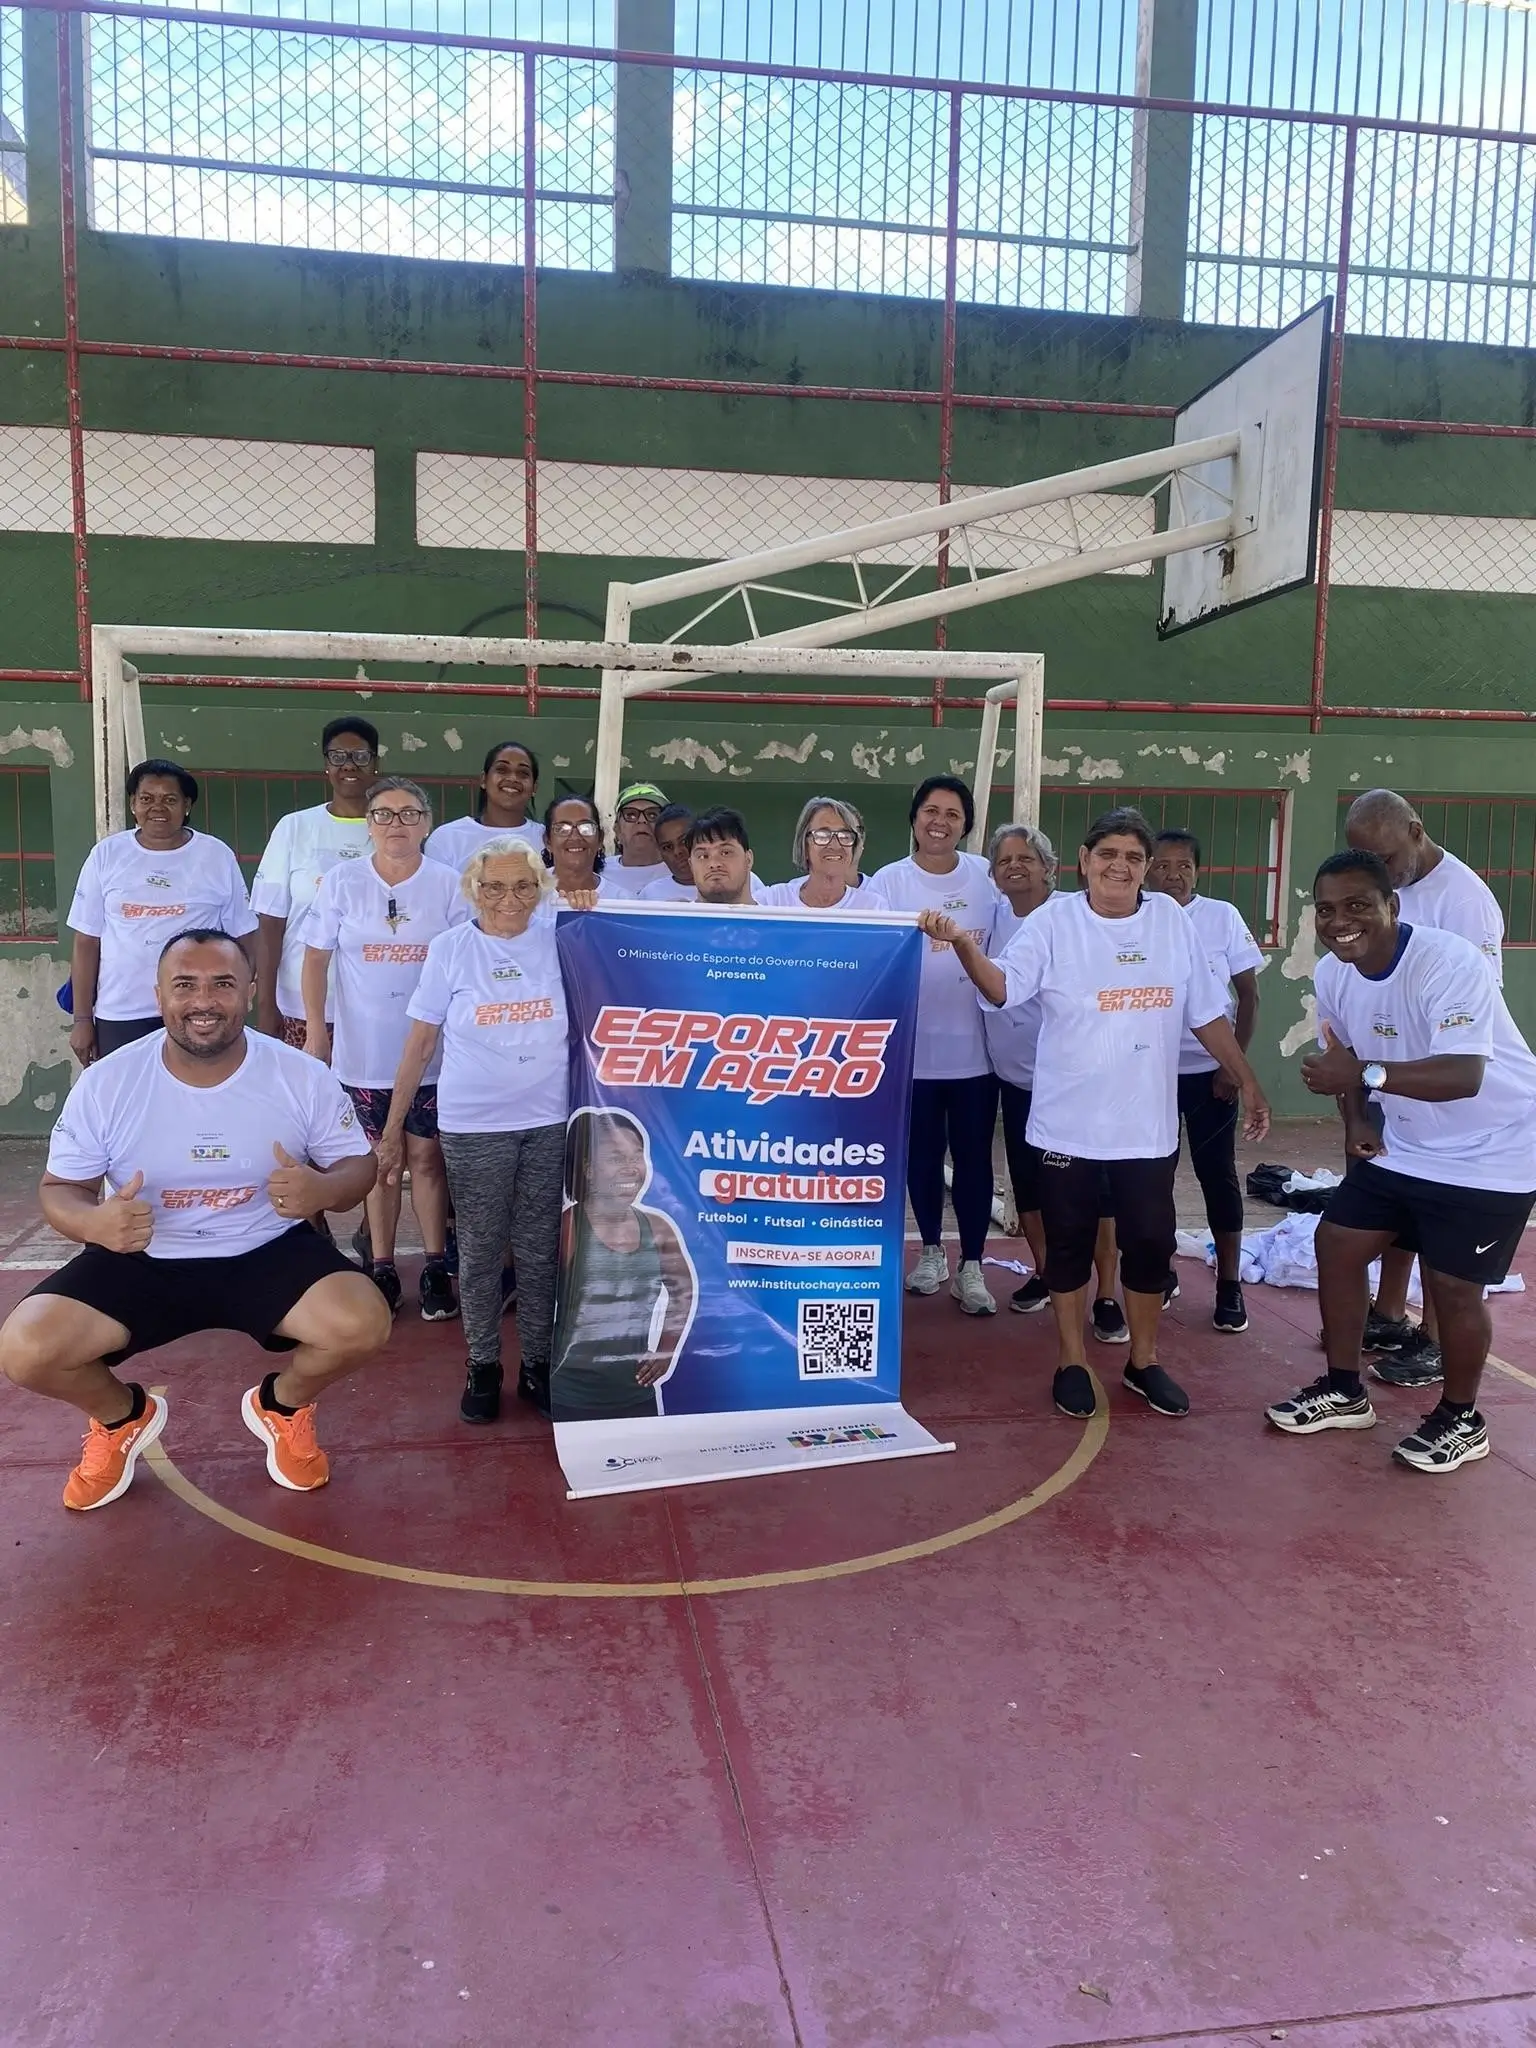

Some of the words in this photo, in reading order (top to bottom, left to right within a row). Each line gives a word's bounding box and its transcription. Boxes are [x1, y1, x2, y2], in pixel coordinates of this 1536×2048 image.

[364, 953, 385, 963] EM
[617, 948, 627, 958] O
[629, 948, 684, 962] Ministério
[685, 952, 700, 963] do
[703, 953, 746, 966] Esporte
[748, 955, 764, 966] do
[765, 956, 814, 968] Governo
[816, 958, 859, 970] Federal
[706, 969, 766, 981] Apresenta
[1097, 986, 1174, 1002] ESPORTE
[475, 998, 552, 1016] ESPORTE
[1100, 1000, 1125, 1012] EM
[477, 1013, 503, 1026] EM
[591, 1006, 897, 1058] ESPORTE
[596, 1047, 697, 1088] EM
[684, 1129, 886, 1166] Atividades
[714, 1171, 884, 1204] gratuitas
[163, 1199, 193, 1209] EM
[698, 1212, 747, 1224] Futebol
[764, 1216, 805, 1228] Futsal
[820, 1216, 883, 1228] Ginástica
[736, 1247, 822, 1262] INSCREVA-SE
[825, 1251, 876, 1261] AGORA!
[728, 1278, 881, 1292] www.institutochaya.com
[120, 1427, 141, 1454] FILA
